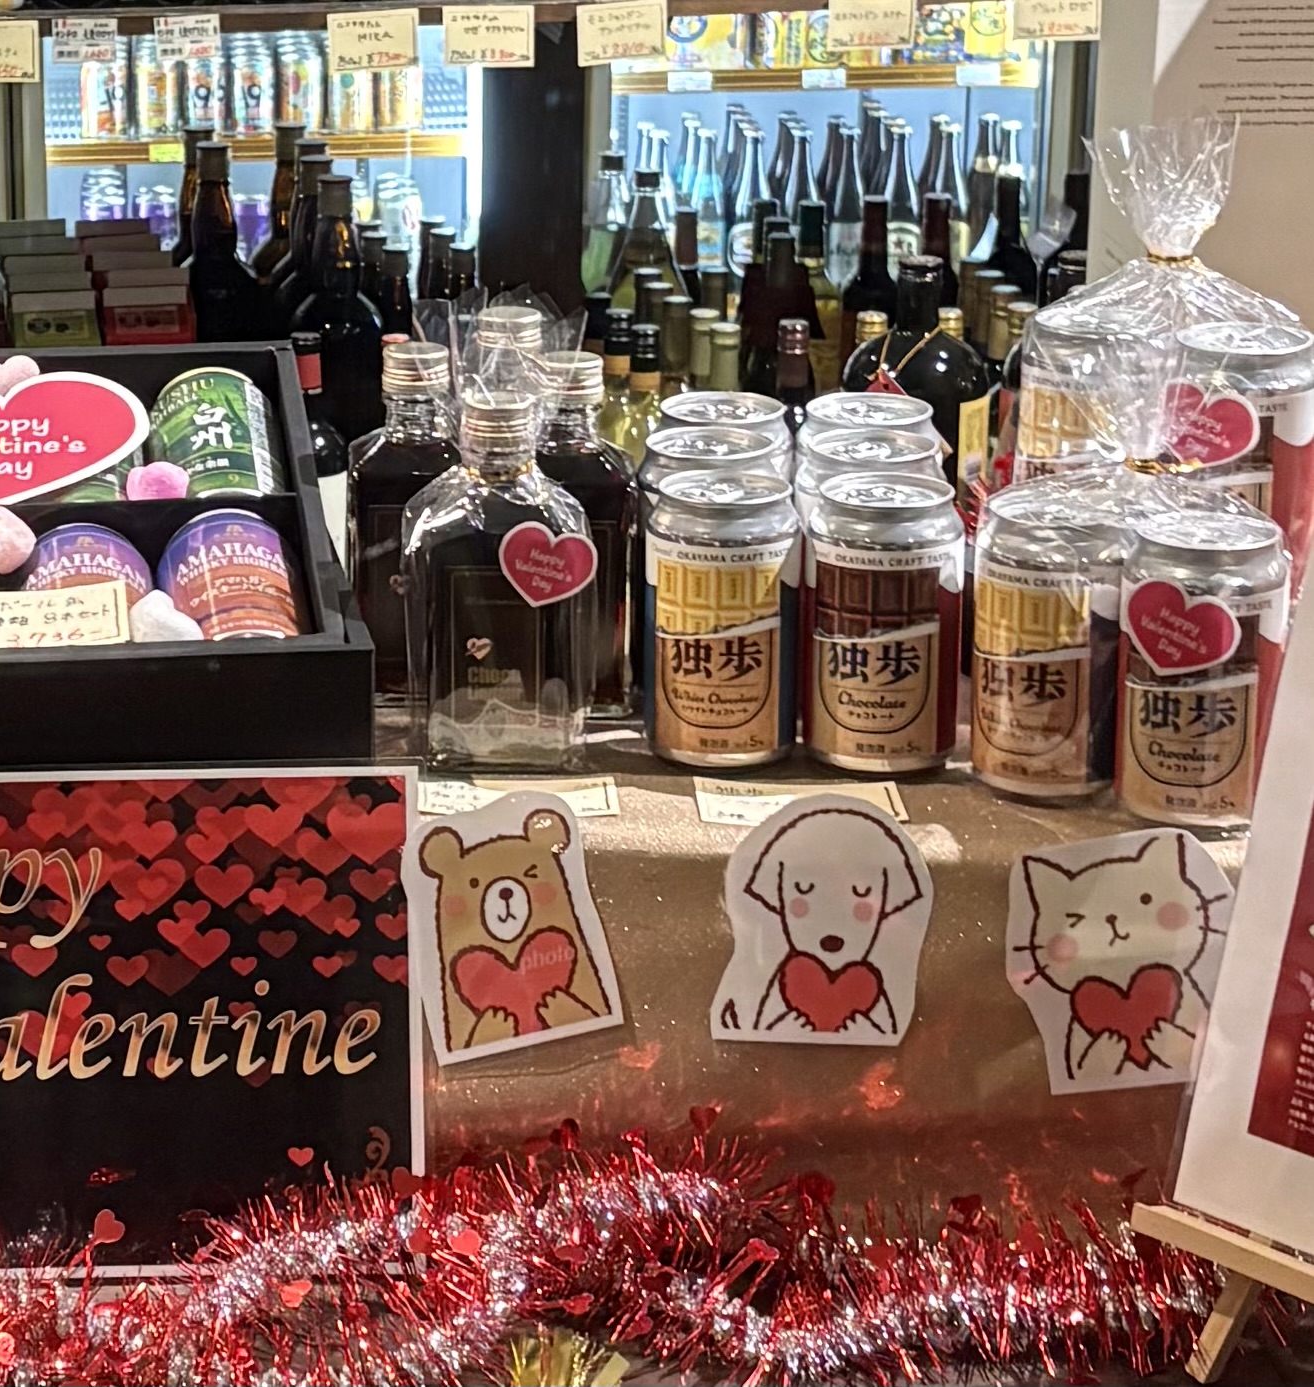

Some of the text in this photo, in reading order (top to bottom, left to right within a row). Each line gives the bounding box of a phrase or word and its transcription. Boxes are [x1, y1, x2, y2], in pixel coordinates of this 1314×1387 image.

[529, 548, 566, 568] Happy
[677, 551, 726, 563] OKAYAMA
[730, 552, 764, 562] CRAFT
[835, 554, 884, 567] OKAYAMA
[888, 556, 923, 567] CRAFT
[515, 559, 573, 583] Valentine's
[531, 575, 553, 593] Day
[671, 636, 764, 682] 独歩
[828, 641, 922, 688] 独歩
[838, 690, 906, 709] Chocolate
[848, 710, 895, 720] チョコレート
[1139, 689, 1238, 739] 独歩
[1149, 740, 1221, 763] Chocolate
